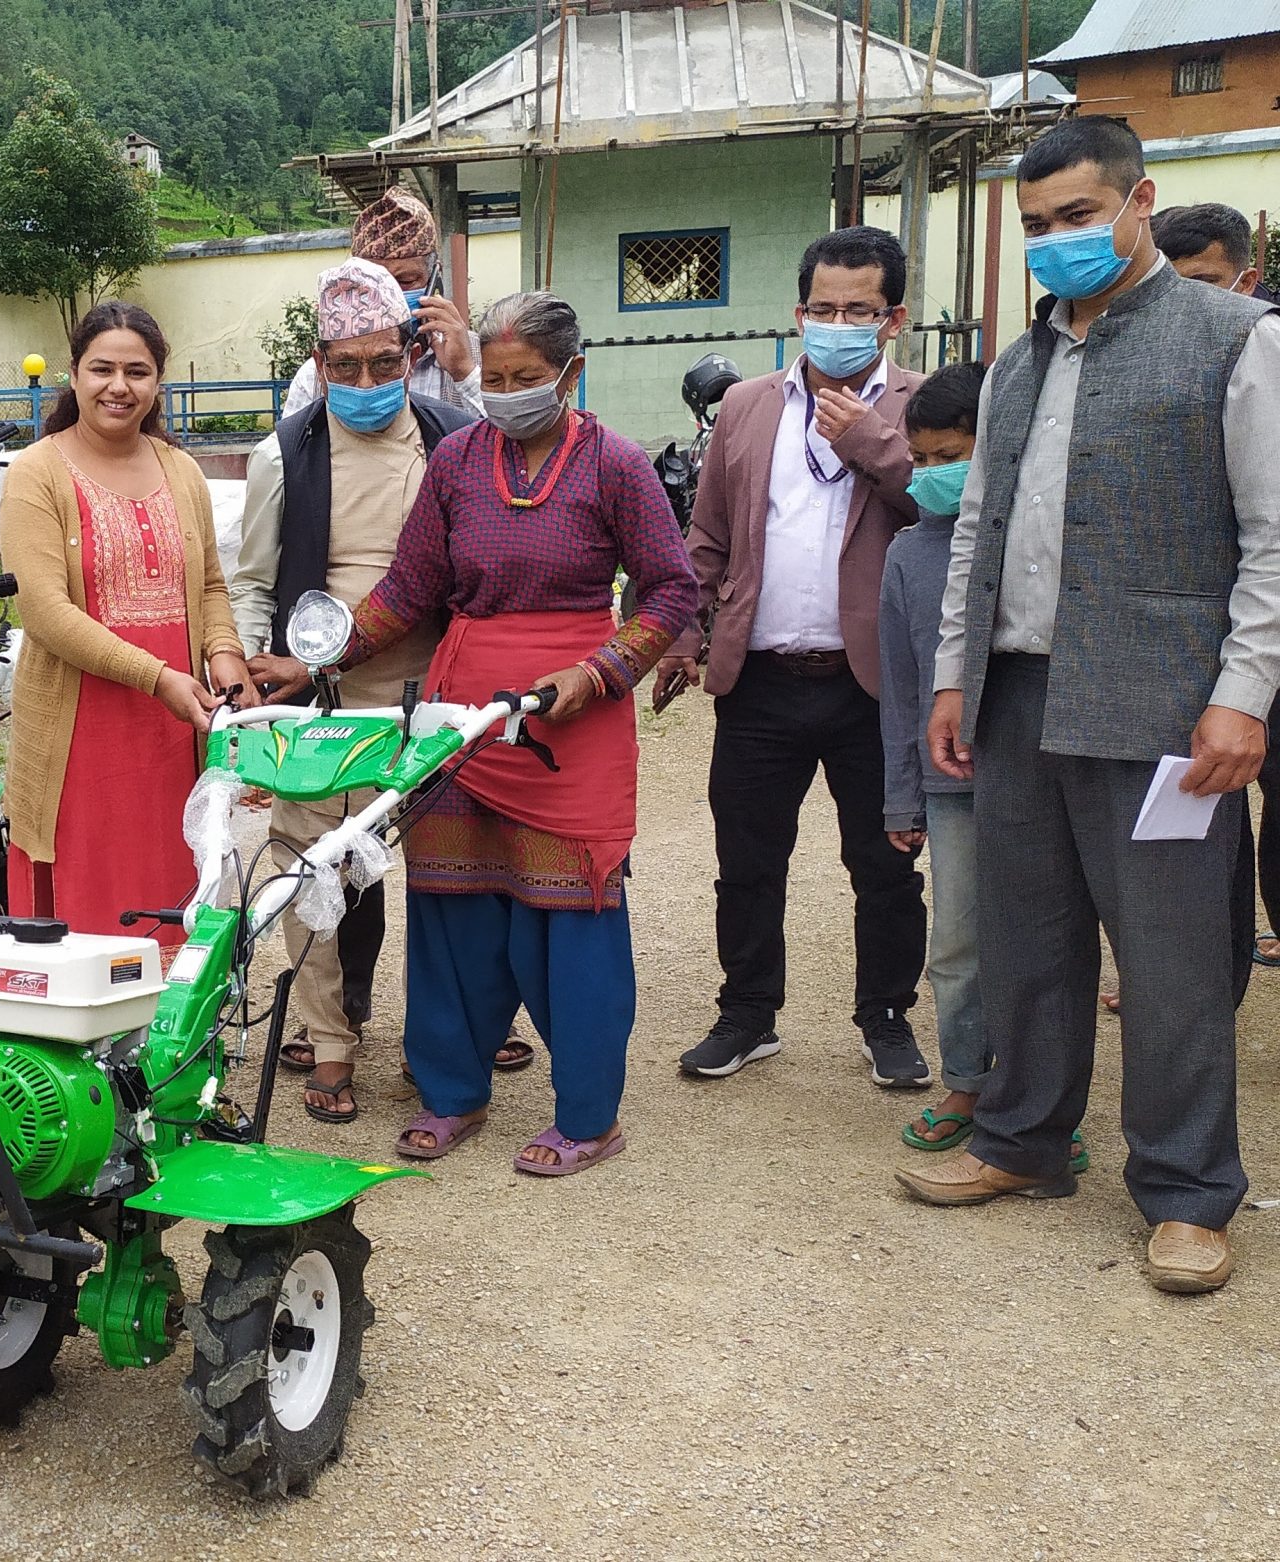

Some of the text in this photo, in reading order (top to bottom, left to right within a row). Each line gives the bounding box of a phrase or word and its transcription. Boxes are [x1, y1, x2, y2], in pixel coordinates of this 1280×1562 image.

[300, 727, 358, 739] KISHAN
[9, 975, 47, 989] SKT
[151, 1019, 169, 1032] CE
